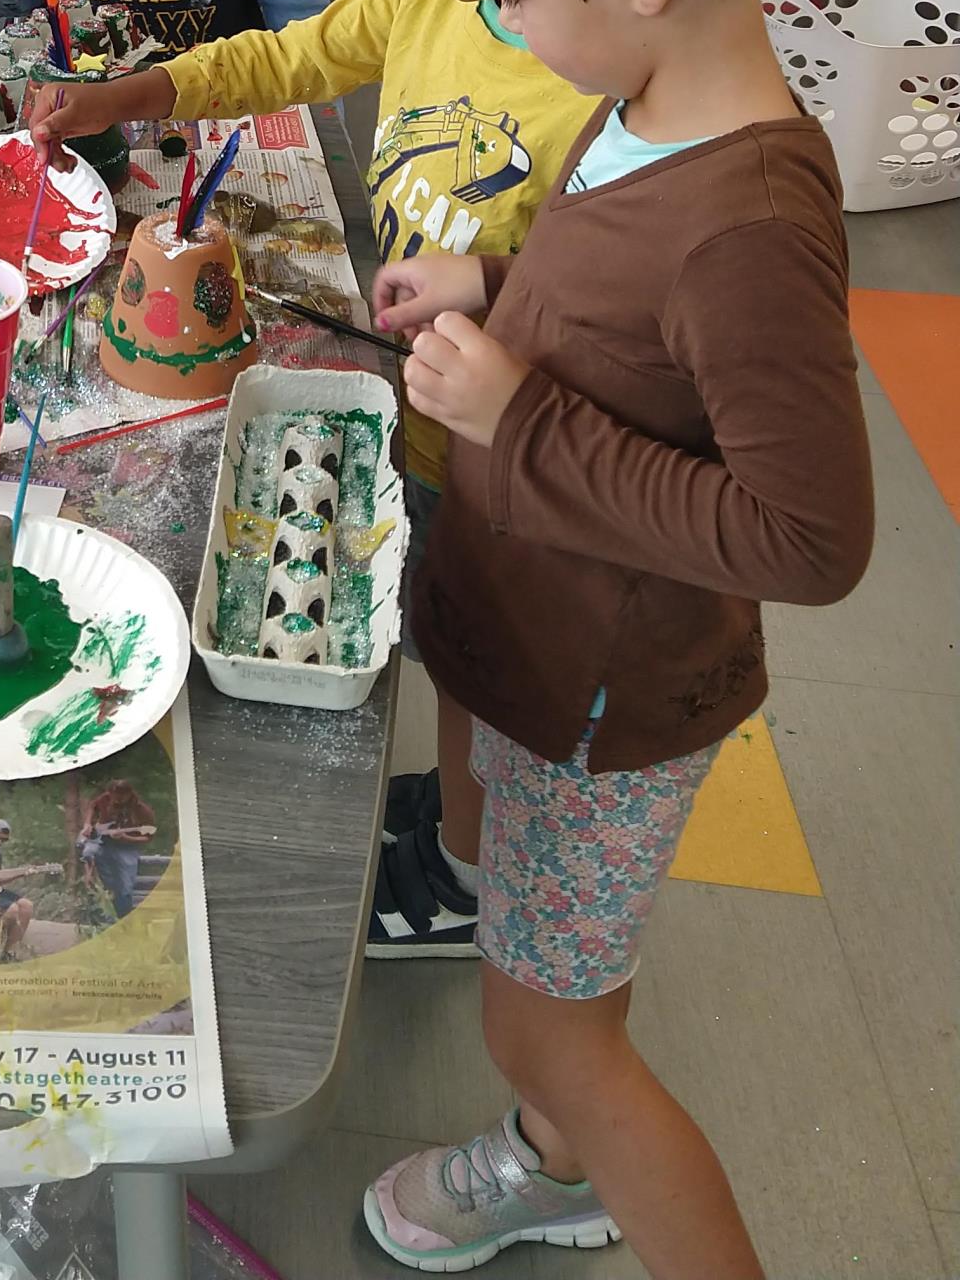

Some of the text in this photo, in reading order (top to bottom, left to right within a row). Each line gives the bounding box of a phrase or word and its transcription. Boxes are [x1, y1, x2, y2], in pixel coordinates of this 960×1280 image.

[404, 176, 482, 256] CAN
[71, 976, 117, 988] Festival
[120, 977, 132, 988] of
[136, 978, 164, 989] Arts
[13, 1046, 39, 1064] 17
[66, 1047, 158, 1069] August
[165, 1050, 186, 1066] 11
[30, 1082, 187, 1116] 547.3100
